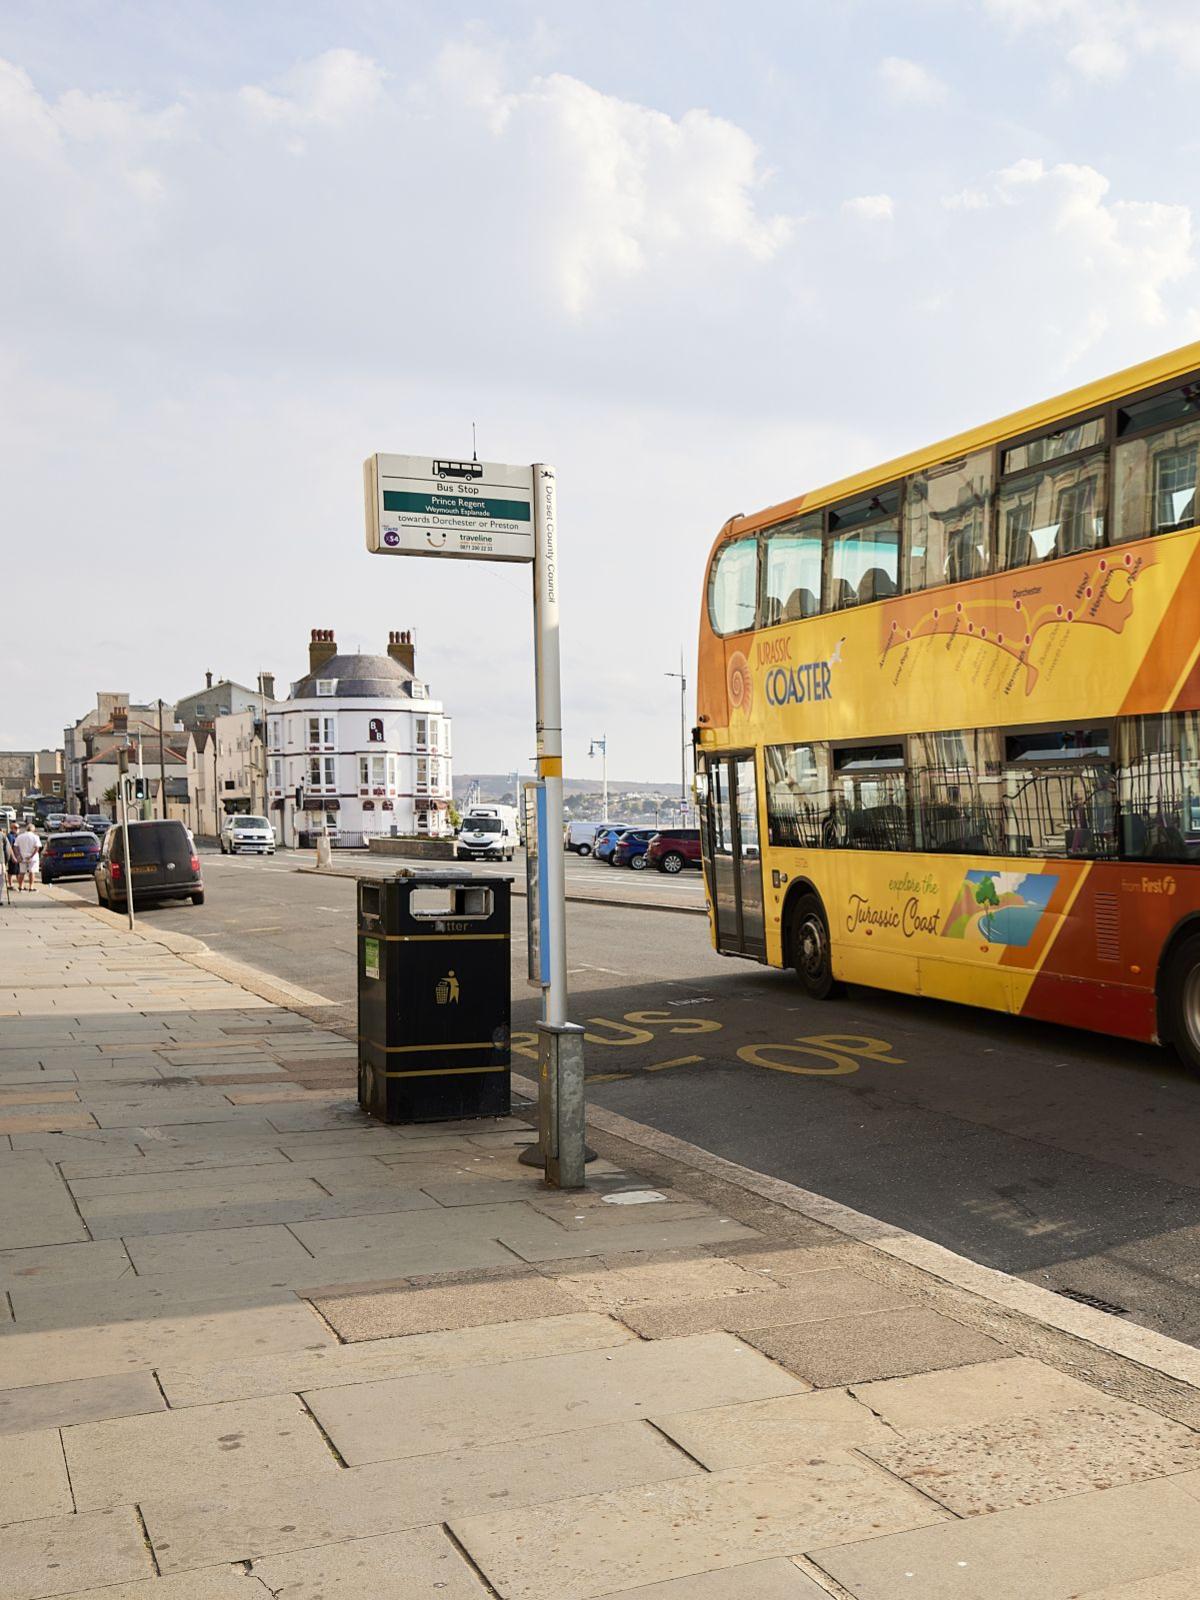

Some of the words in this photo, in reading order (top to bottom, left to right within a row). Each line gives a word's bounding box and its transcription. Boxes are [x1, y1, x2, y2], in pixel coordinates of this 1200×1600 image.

[437, 483, 454, 492] Bus
[458, 485, 479, 495] Stop
[425, 505, 460, 514] Weymouth
[460, 509, 490, 517] Esplanade
[431, 496, 456, 506] Prince
[458, 498, 485, 509] Regent
[545, 485, 553, 520] Dorset
[398, 514, 430, 524] towards
[432, 516, 477, 527] Dorchester
[490, 520, 519, 530] Preston
[460, 534, 493, 543] traveline
[545, 523, 554, 561] County
[547, 564, 556, 603] Council
[756, 636, 792, 671] JURASSIC
[766, 661, 832, 706] COASTER
[889, 872, 921, 898] explore
[922, 873, 938, 895] the
[1141, 877, 1163, 894] First
[846, 894, 900, 933] Jurassic
[902, 897, 940, 938] Coast
